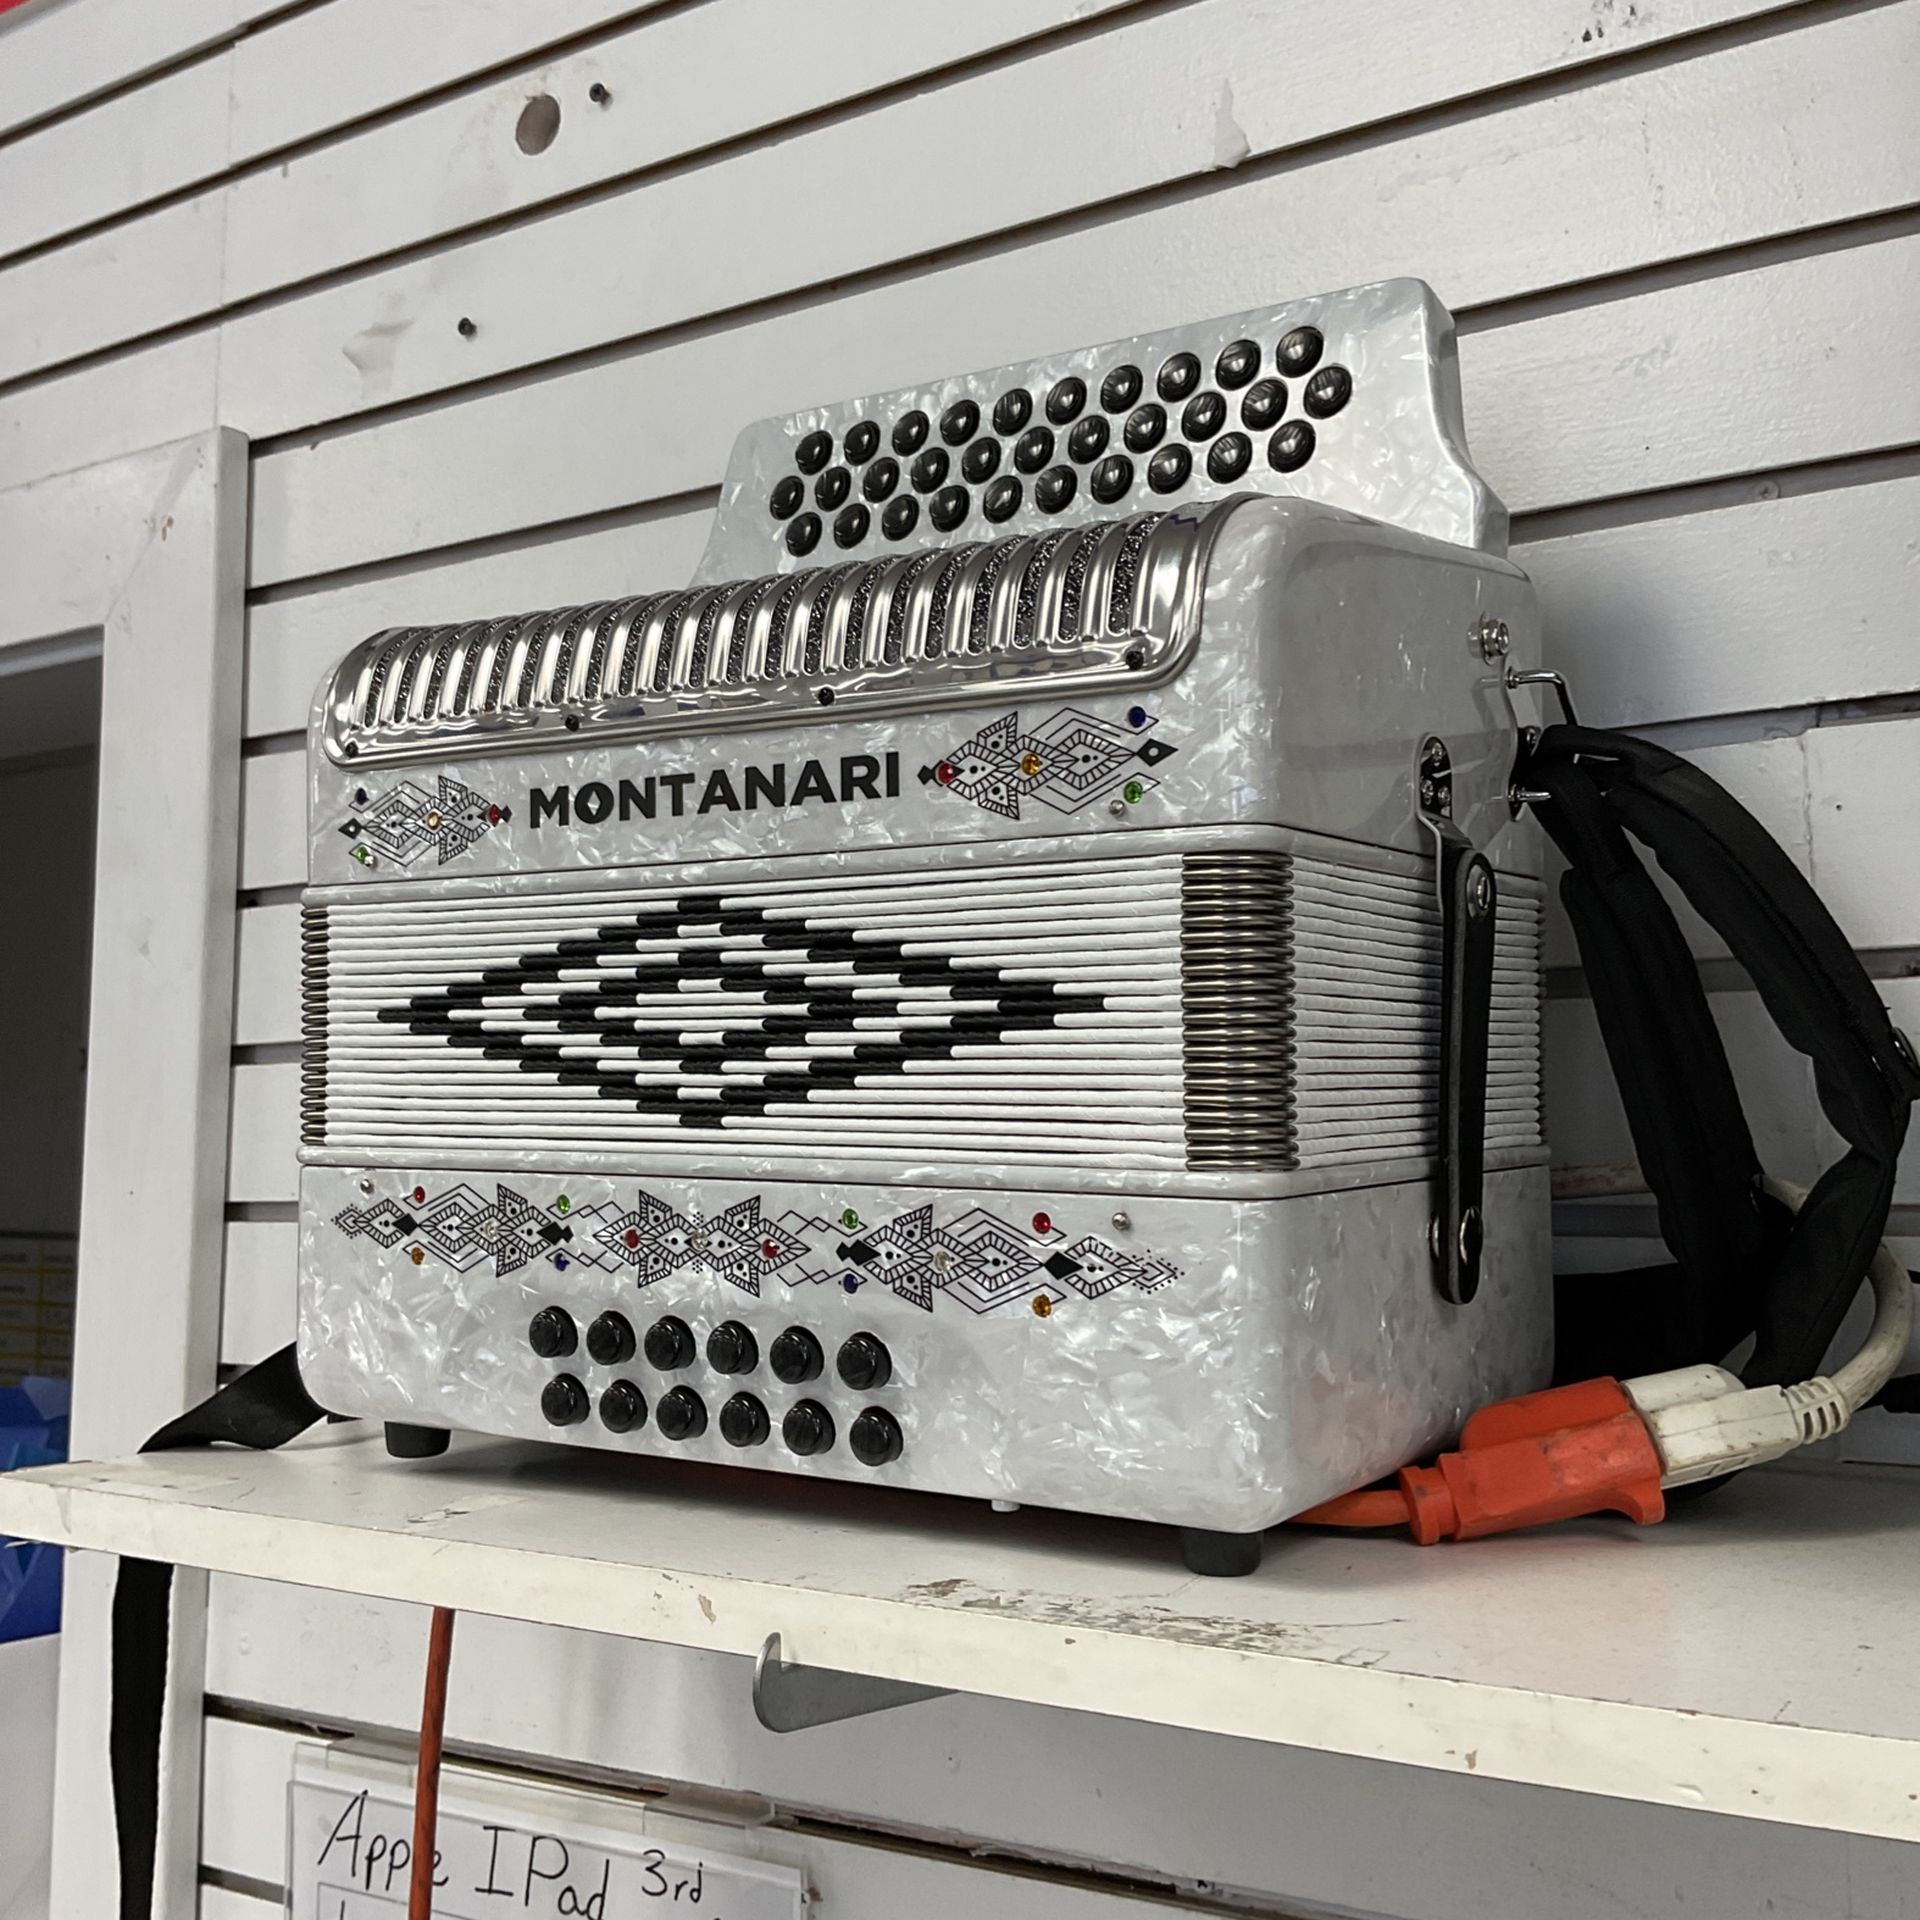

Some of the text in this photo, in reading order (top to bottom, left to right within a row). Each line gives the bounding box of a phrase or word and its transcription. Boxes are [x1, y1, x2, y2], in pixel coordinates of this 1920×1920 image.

[530, 752, 900, 829] MONTANARI
[317, 1789, 449, 1891] Appe
[641, 1849, 703, 1903] 3rd
